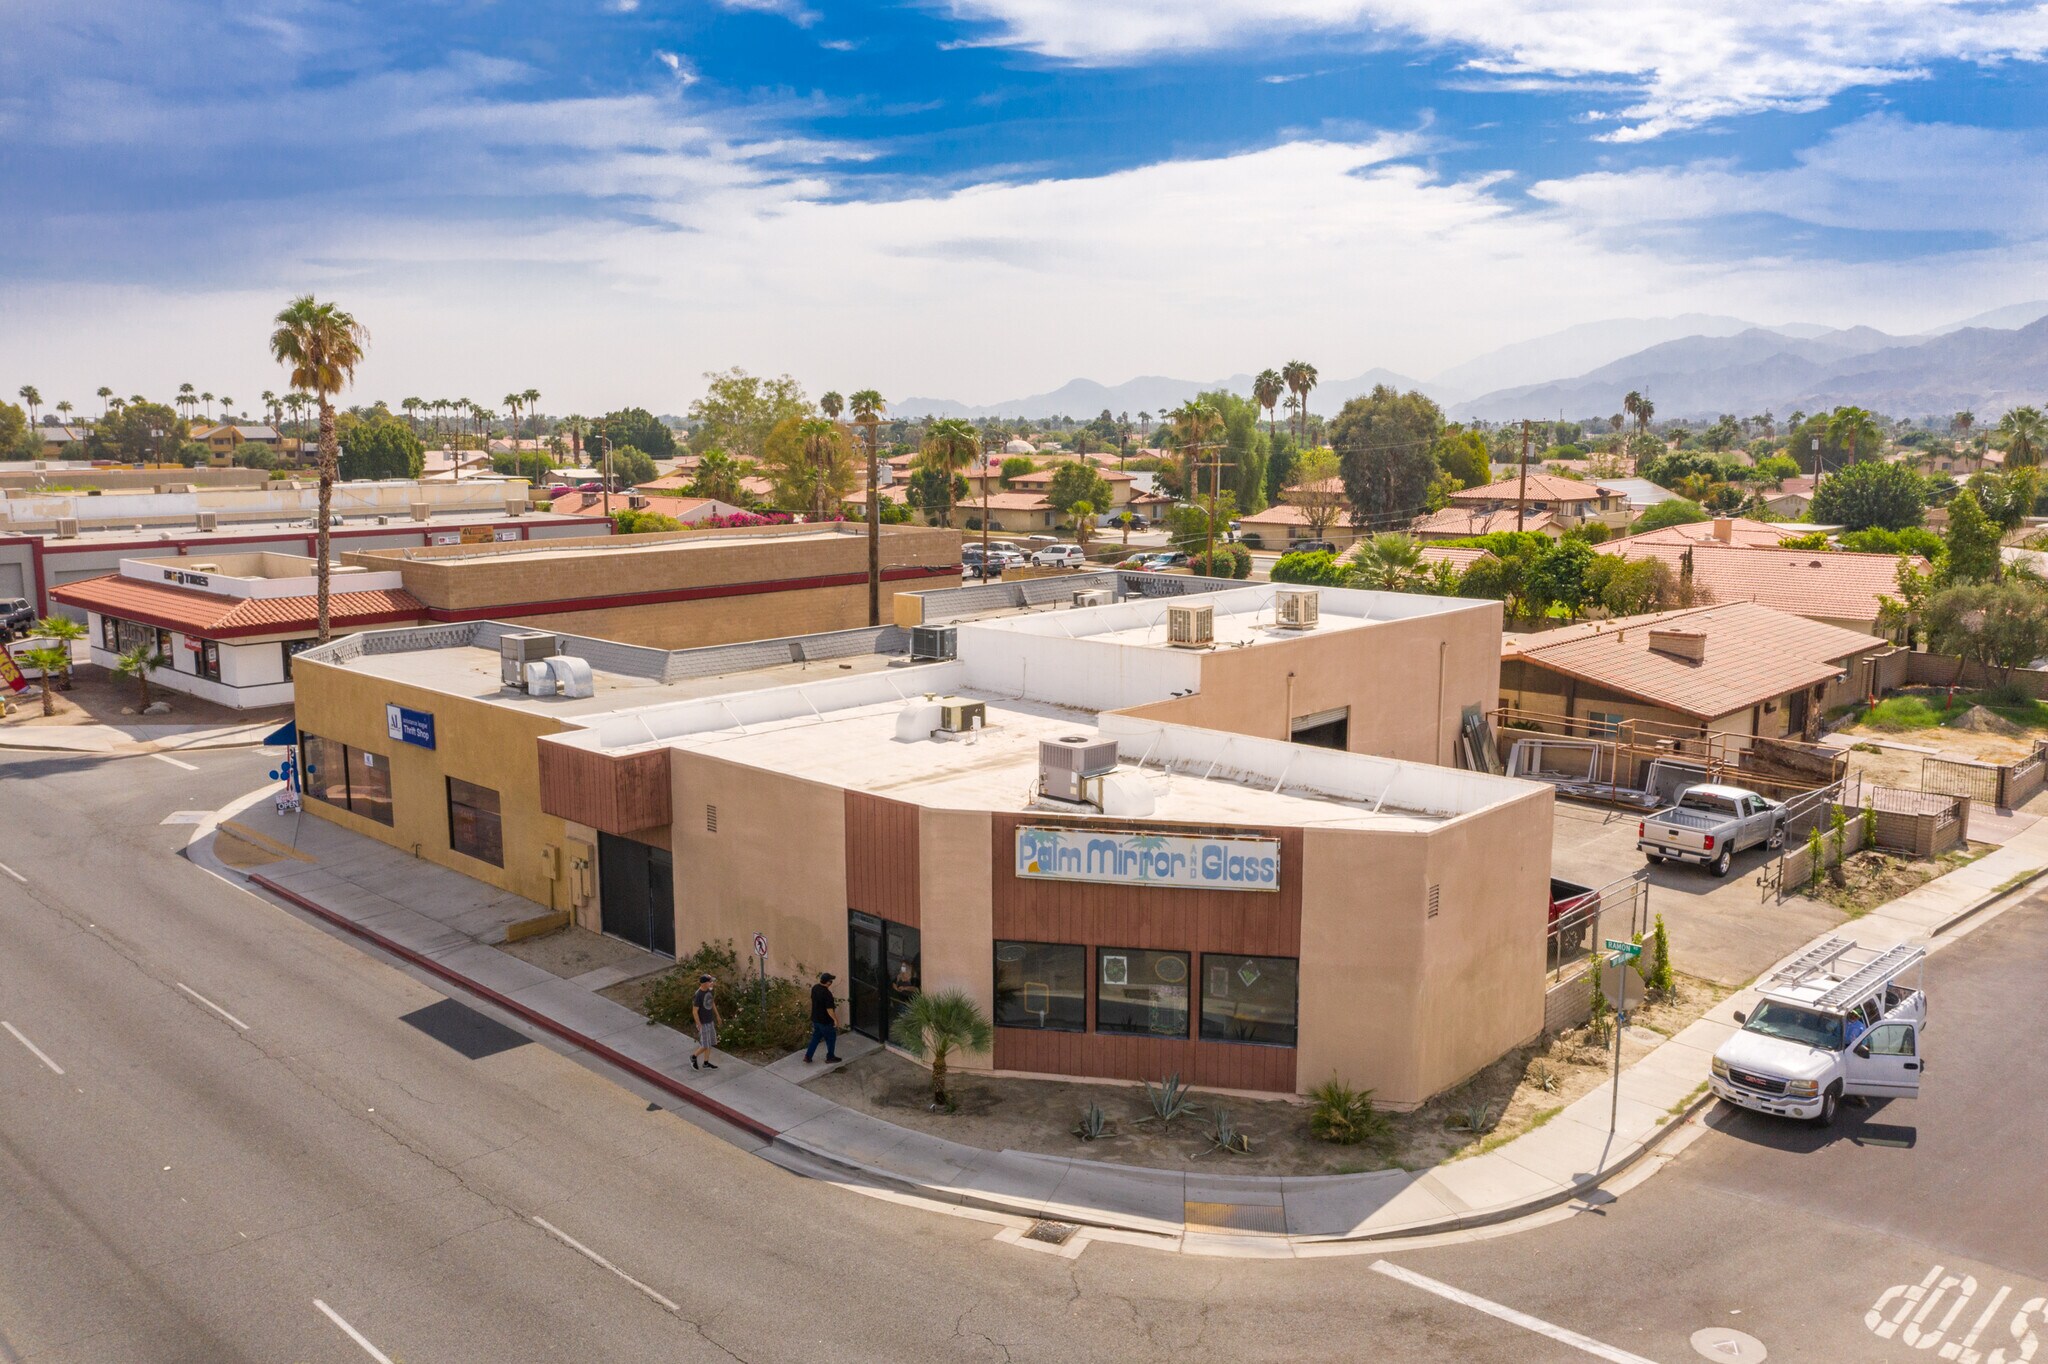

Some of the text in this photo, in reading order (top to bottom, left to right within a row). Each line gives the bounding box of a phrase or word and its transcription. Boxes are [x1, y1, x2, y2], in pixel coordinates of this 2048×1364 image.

[403, 724, 430, 741] Thrift Shop
[278, 801, 299, 810] OPEN
[1019, 834, 1082, 874] Palm
[1086, 838, 1186, 879] Mirror
[1201, 844, 1275, 883] Glass
[1608, 941, 1630, 951] RAMON
